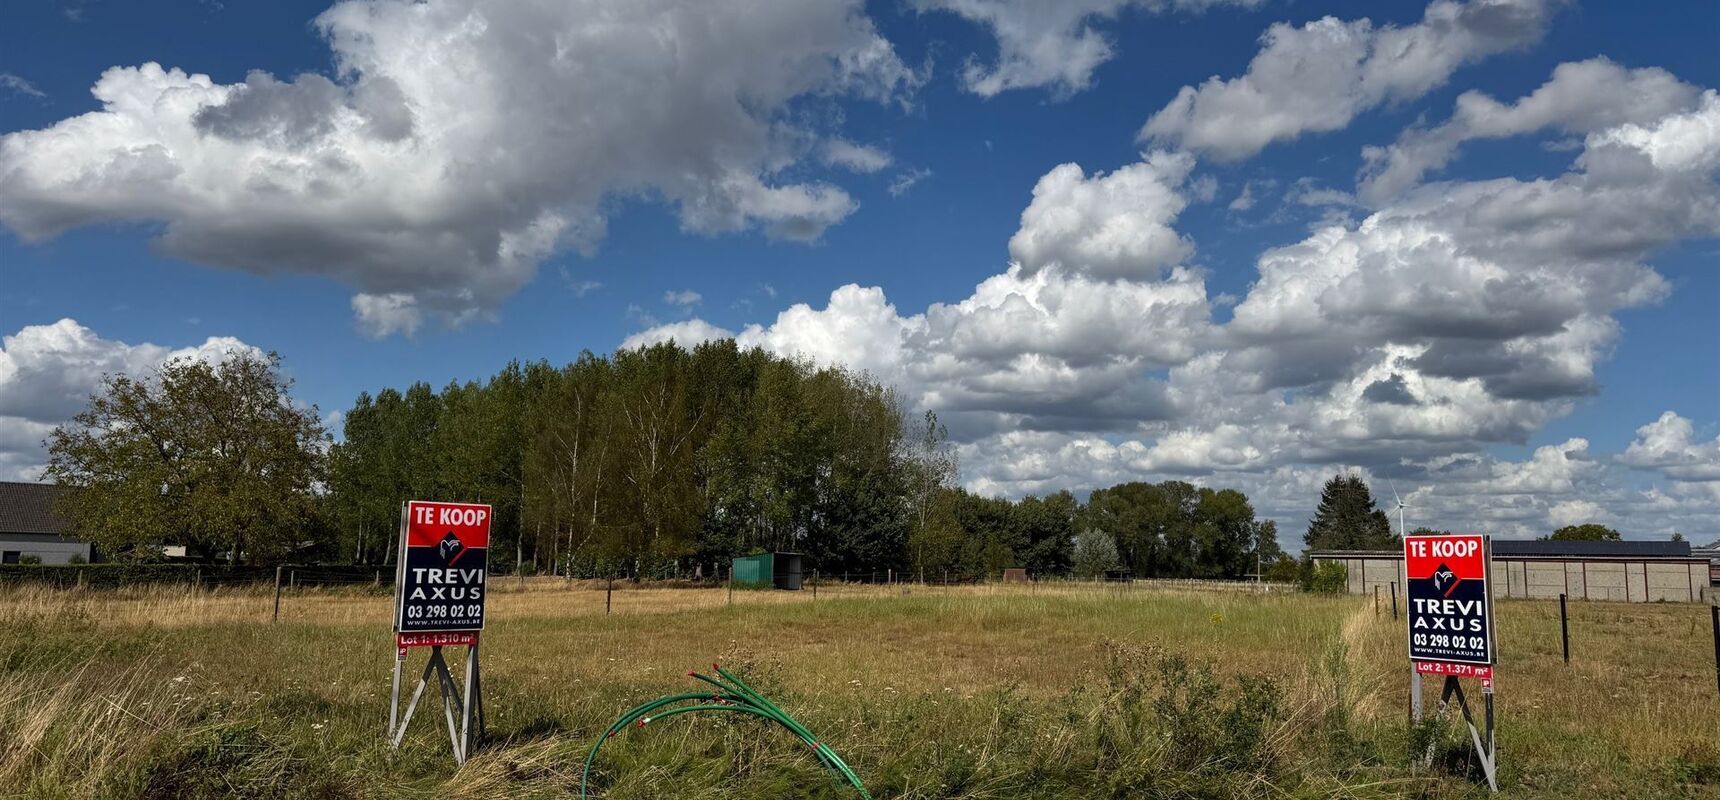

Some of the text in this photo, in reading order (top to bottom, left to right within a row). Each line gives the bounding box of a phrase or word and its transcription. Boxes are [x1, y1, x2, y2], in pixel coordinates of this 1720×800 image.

[416, 507, 486, 526] TE KOOP
[1410, 541, 1477, 557] TE KOOP
[413, 568, 483, 584] TREVI
[409, 587, 480, 599] AXUS
[408, 605, 480, 618] 03 298 02 02
[1414, 599, 1482, 616] TREVI
[1414, 617, 1481, 631] AXUS
[401, 636, 417, 644] Lot
[434, 634, 458, 643] 1.310
[1414, 634, 1483, 649] 03 298 02 02
[1418, 662, 1432, 671] Lot
[1435, 663, 1443, 672] 2:
[1446, 664, 1471, 674] 1.371
